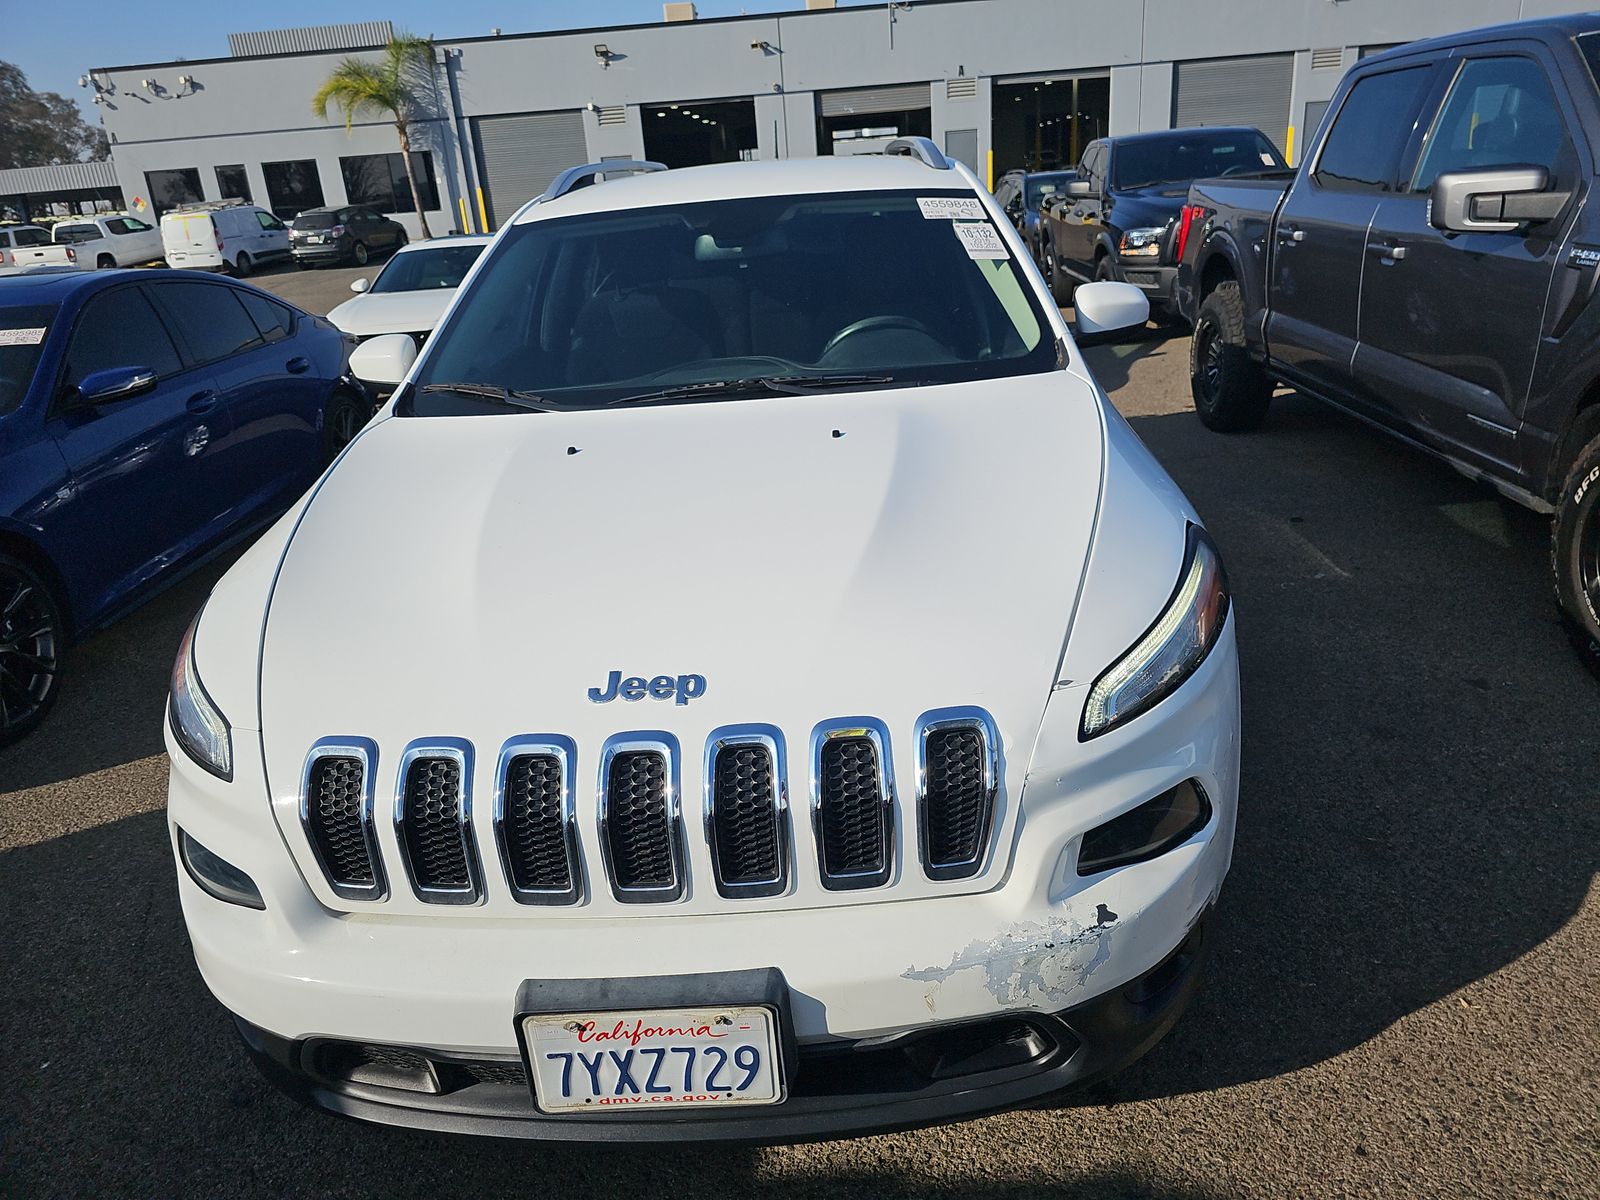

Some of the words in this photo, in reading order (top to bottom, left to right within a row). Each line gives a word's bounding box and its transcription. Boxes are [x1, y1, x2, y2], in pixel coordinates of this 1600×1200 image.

[923, 200, 977, 209] 4559848
[588, 670, 708, 706] Jeep
[577, 1019, 728, 1046] California
[546, 1045, 761, 1097] 7YXZ729
[599, 1093, 720, 1105] dmv.ca.gov
